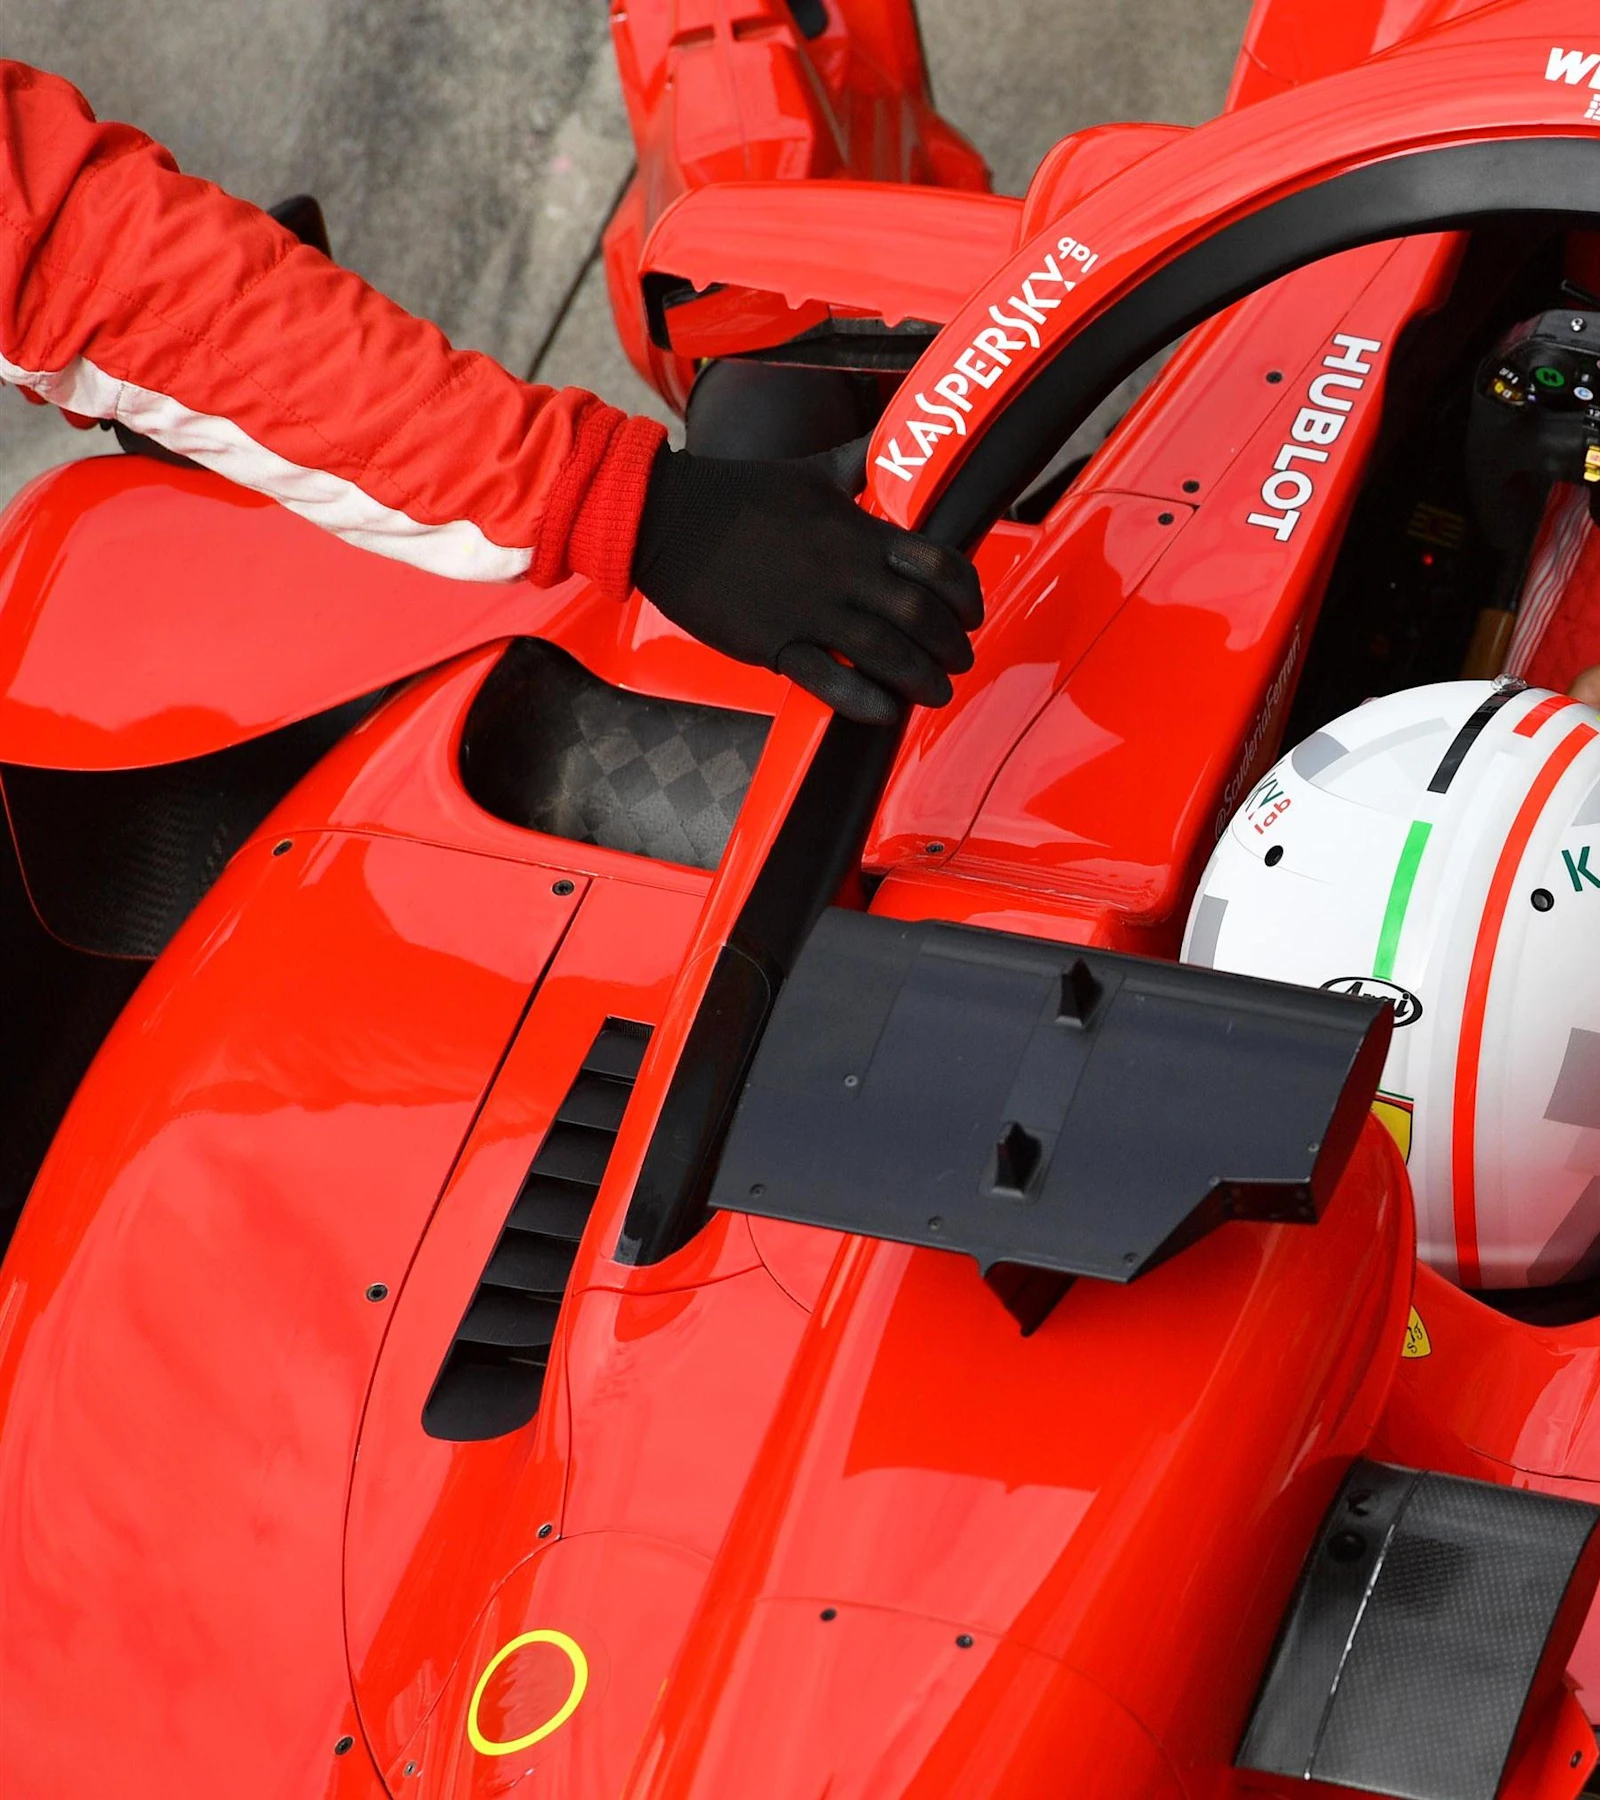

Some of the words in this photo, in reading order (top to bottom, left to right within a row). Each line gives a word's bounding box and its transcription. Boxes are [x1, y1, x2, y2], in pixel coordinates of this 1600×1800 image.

[874, 253, 1077, 482] KASPERSKY
[1056, 236, 1099, 274] lab
[1246, 333, 1383, 542] HUBLOT
[1254, 798, 1292, 835] lab
